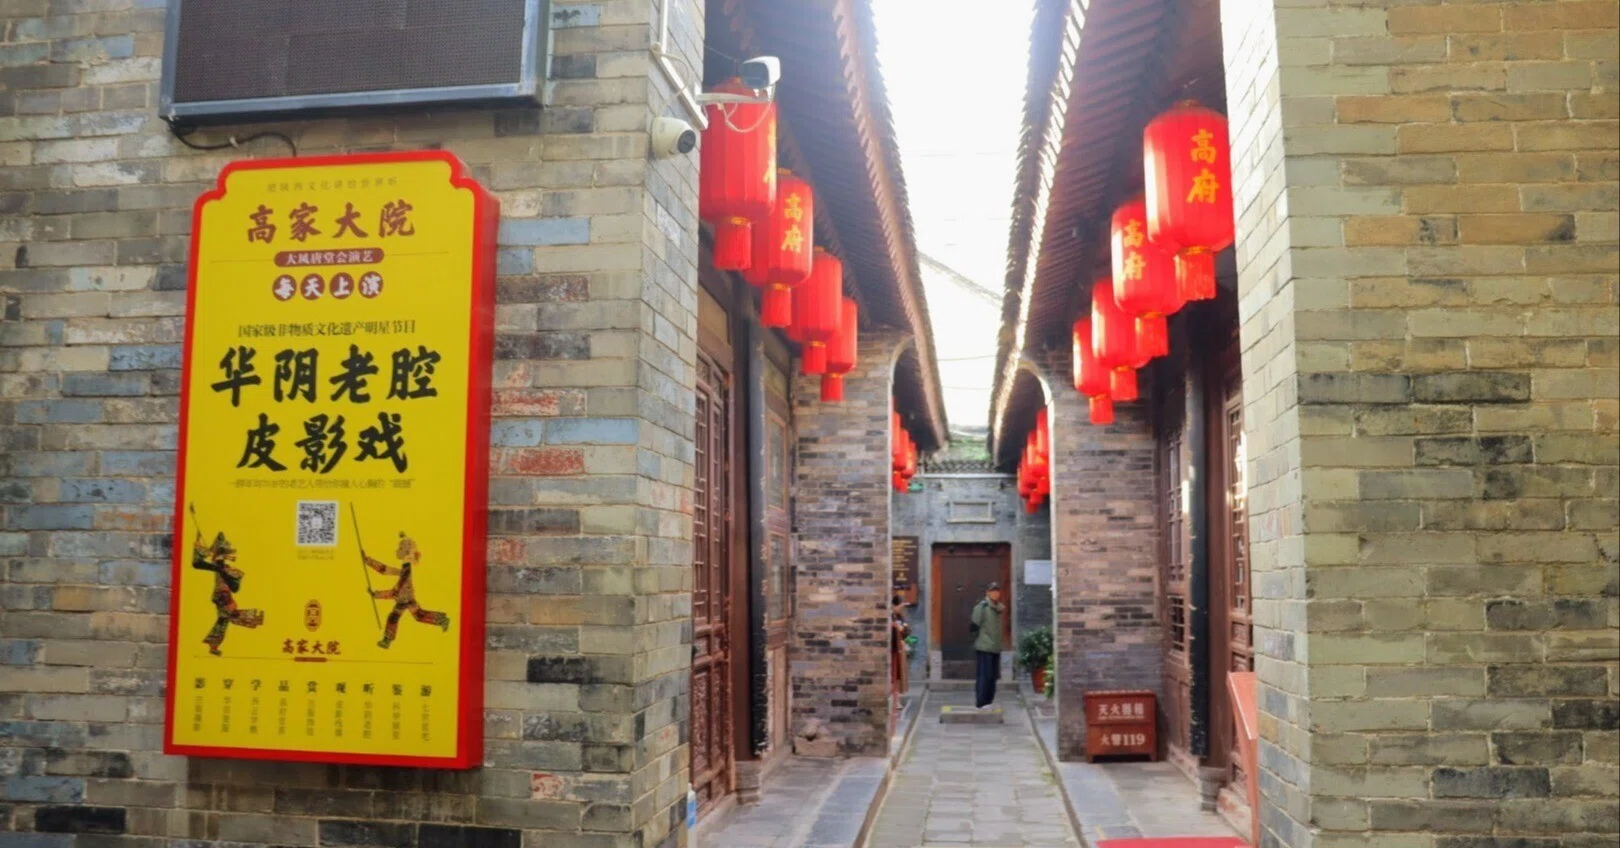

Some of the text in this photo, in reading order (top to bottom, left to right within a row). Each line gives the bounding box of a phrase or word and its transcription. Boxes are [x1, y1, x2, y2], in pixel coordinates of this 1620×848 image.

[1186, 128, 1220, 204] 高府
[247, 200, 415, 244] 高家大院
[781, 192, 804, 252] 高府
[1123, 218, 1146, 280] 高府
[274, 273, 381, 299] 每天上演
[238, 319, 416, 338] 国家级非物质文化遗产明星节目
[210, 343, 441, 407] 华阴老腔
[235, 412, 409, 474] 皮影戏
[282, 638, 341, 655] 高家大院
[278, 680, 290, 692] 品
[1100, 733, 1146, 746] 火警119
